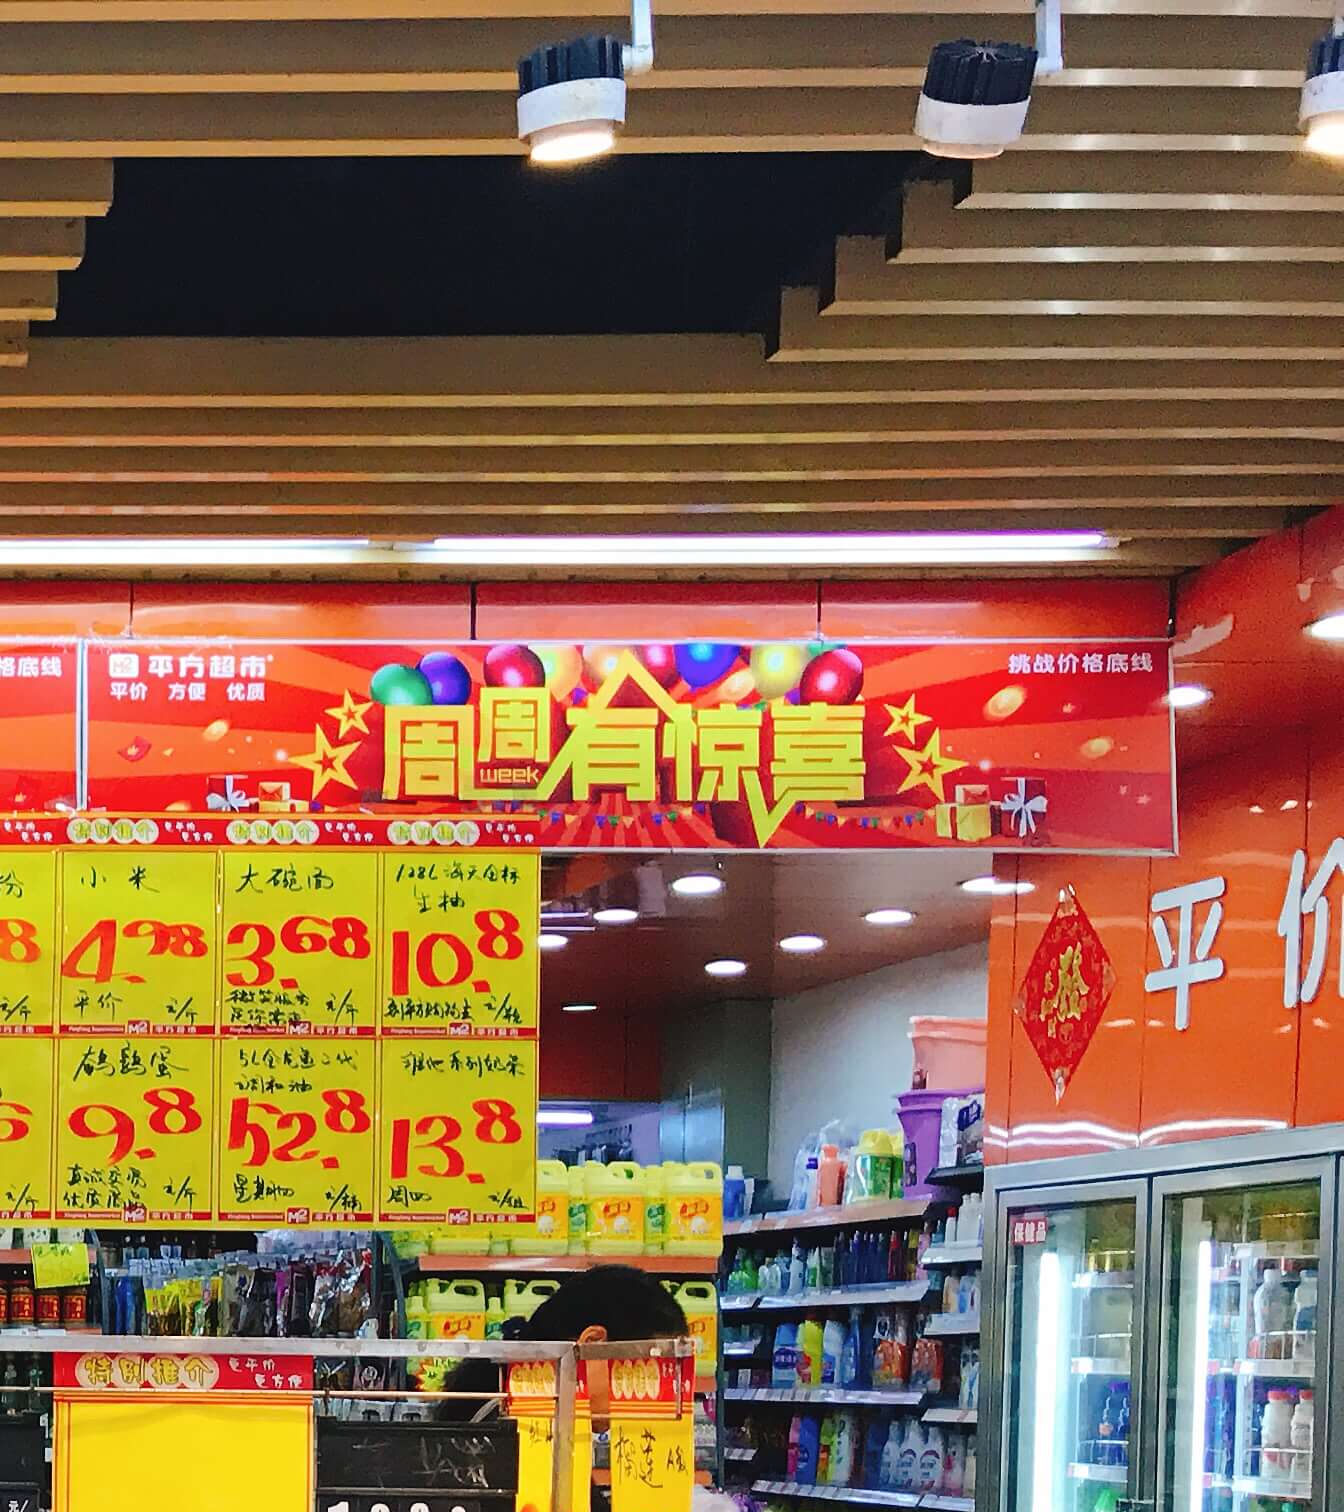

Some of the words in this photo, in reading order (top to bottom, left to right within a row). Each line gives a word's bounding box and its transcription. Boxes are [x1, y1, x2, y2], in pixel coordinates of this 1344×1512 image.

[148, 655, 268, 679] 平方超市
[1008, 652, 1153, 675] 挑战价格底线
[111, 683, 147, 701] 平价
[169, 683, 205, 701] 方便
[227, 683, 265, 701] 优质
[383, 650, 865, 847] 周周有惊喜
[480, 767, 539, 785] week
[80, 867, 160, 893] 小米
[235, 863, 334, 893] 大碗面
[62, 919, 209, 984] 4.98
[227, 915, 371, 988] 3.68
[392, 910, 524, 996] 10.8
[73, 993, 124, 1018] 平价
[67, 1087, 203, 1166] 9.8
[228, 1088, 370, 1168] 52.8
[391, 1098, 522, 1184] 13.8
[85, 1357, 212, 1385] 特别推介
